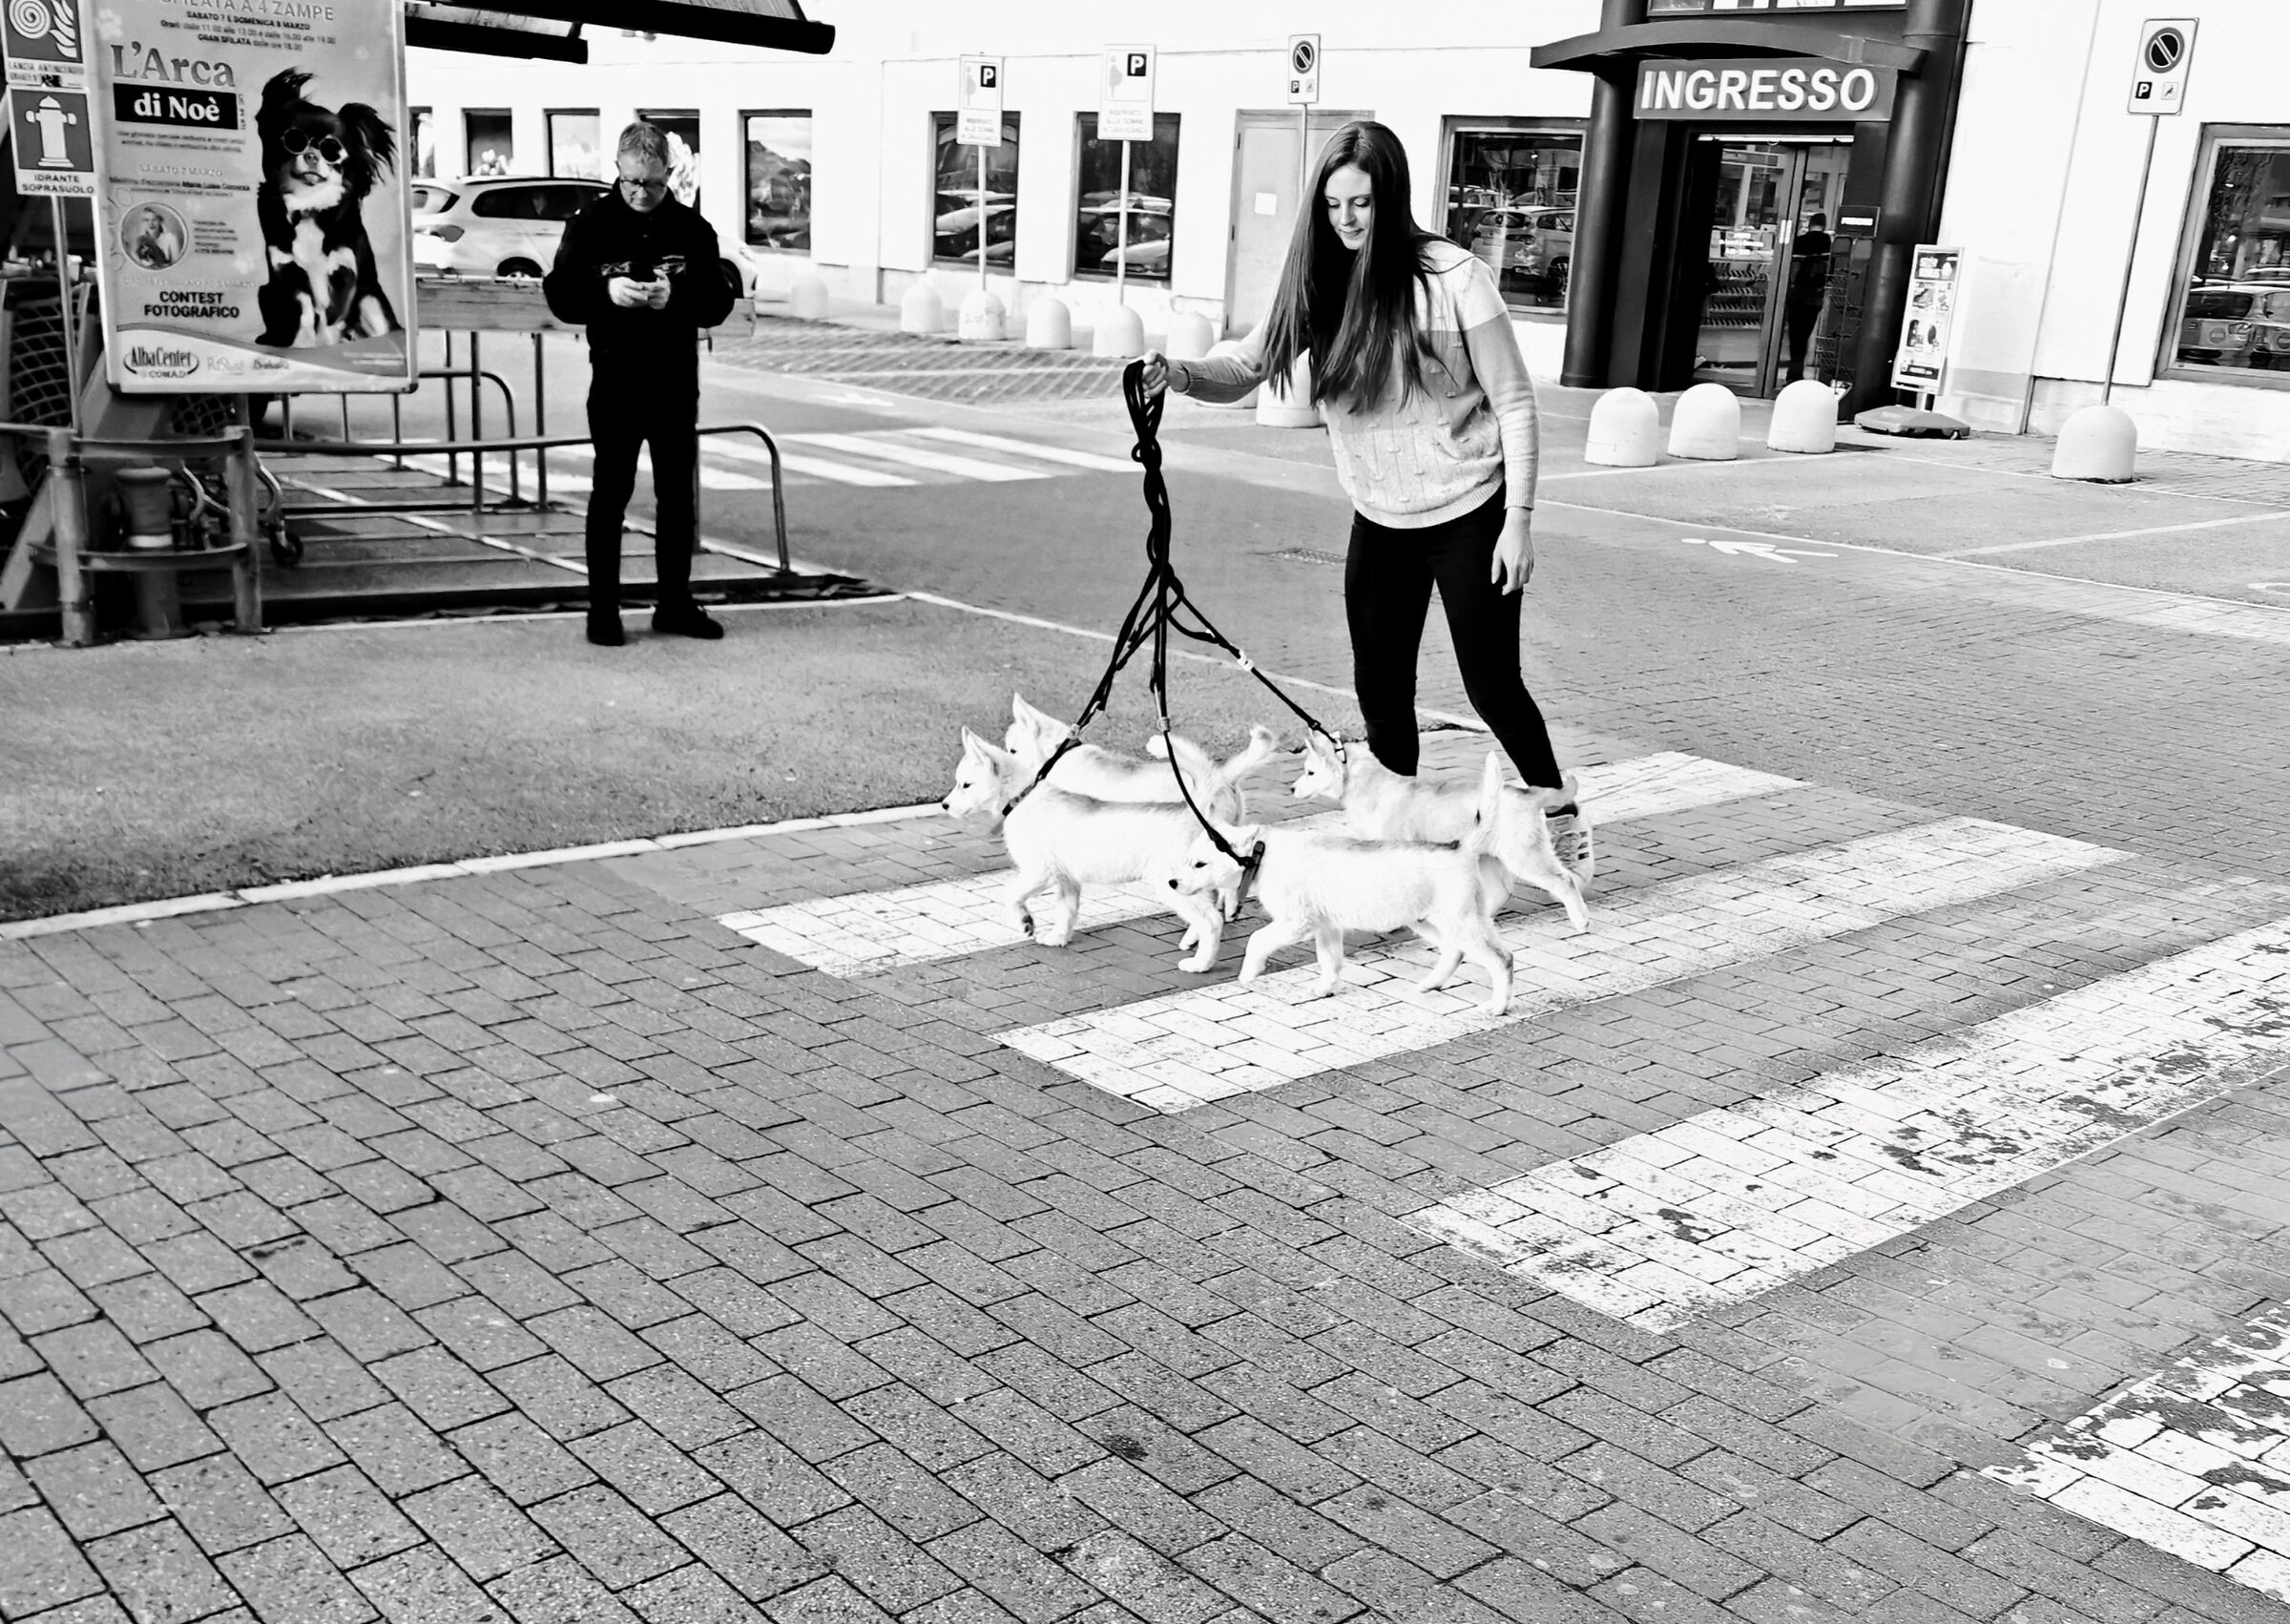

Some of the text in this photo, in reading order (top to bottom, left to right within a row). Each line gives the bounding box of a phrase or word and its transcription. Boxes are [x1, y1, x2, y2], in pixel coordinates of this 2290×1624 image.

[258, 1, 267, 13] 4
[273, 1, 335, 21] ZAMPE
[186, 10, 219, 21] SABATO
[234, 15, 275, 27] DOMENICA
[283, 20, 311, 31] MARZO
[198, 33, 219, 42] GRAN
[220, 36, 251, 46] SFILATA
[111, 41, 236, 87] L'Arca
[1131, 55, 1145, 74] P
[983, 67, 995, 85] P
[1641, 68, 1877, 112] INGRESSO
[2137, 83, 2150, 97] P
[134, 92, 162, 116] di
[168, 96, 220, 122] Noè
[34, 174, 80, 183] IDRANTE
[22, 183, 94, 194] SOPRASUOLO
[159, 290, 224, 304] CONTEST
[144, 304, 240, 319] FOTOGRAFICO
[132, 346, 191, 366] AlbaCenter
